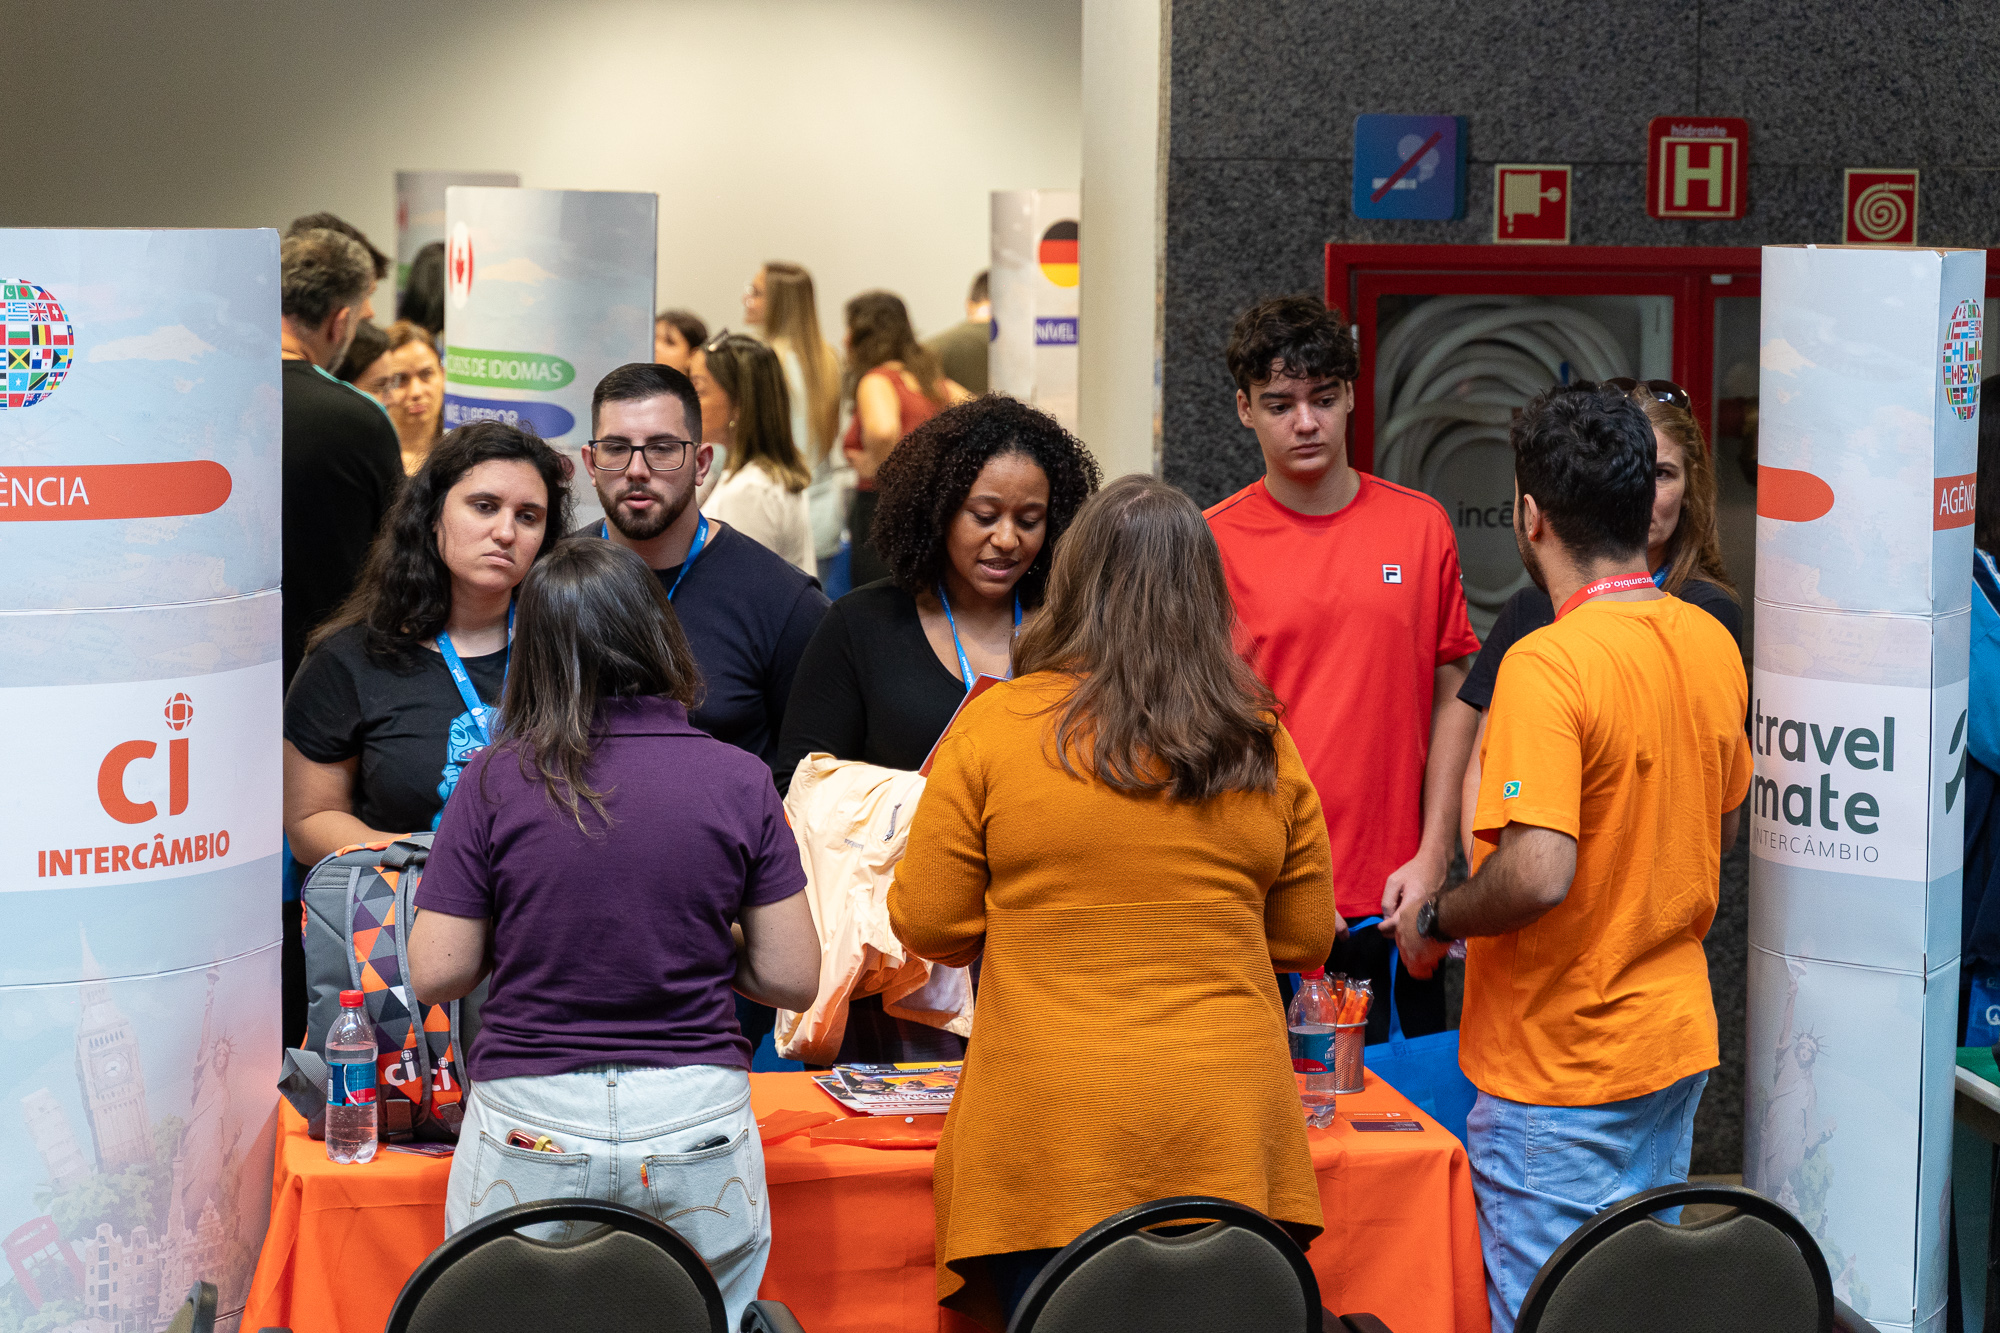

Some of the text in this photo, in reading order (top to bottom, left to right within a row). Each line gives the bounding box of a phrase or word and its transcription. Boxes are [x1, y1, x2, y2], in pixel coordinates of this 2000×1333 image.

[1673, 145, 1723, 207] H
[471, 357, 488, 379] DE
[488, 359, 563, 382] IDIOMAS
[97, 692, 194, 825] ci
[1755, 698, 1895, 772] travel
[1754, 772, 1880, 835] mate
[37, 829, 230, 878] INTERCÂMBIO
